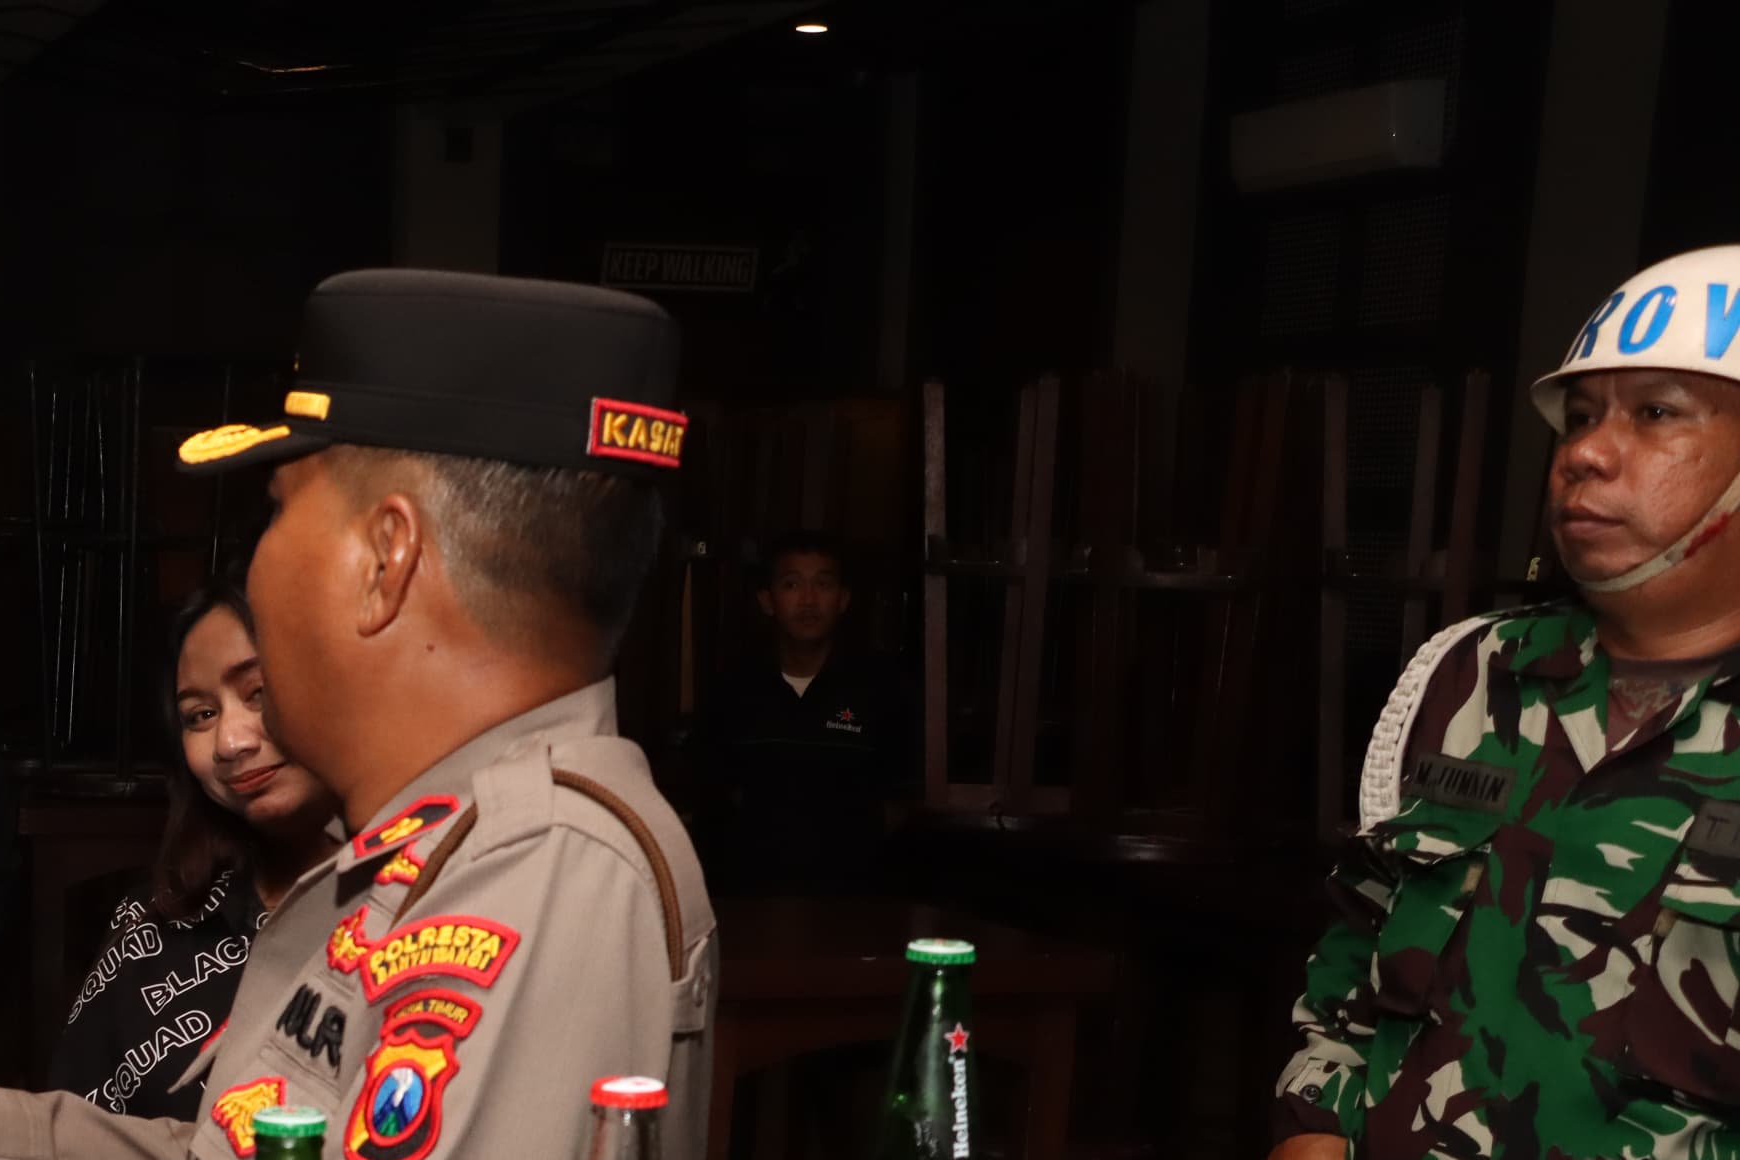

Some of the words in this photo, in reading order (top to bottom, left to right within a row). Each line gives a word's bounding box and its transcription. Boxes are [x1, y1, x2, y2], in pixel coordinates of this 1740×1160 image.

[610, 251, 658, 281] KEEP
[662, 252, 752, 285] WALKING
[140, 935, 251, 1017] BLAC
[370, 924, 501, 975] POLRESTA
[950, 1057, 970, 1160] Heineken
